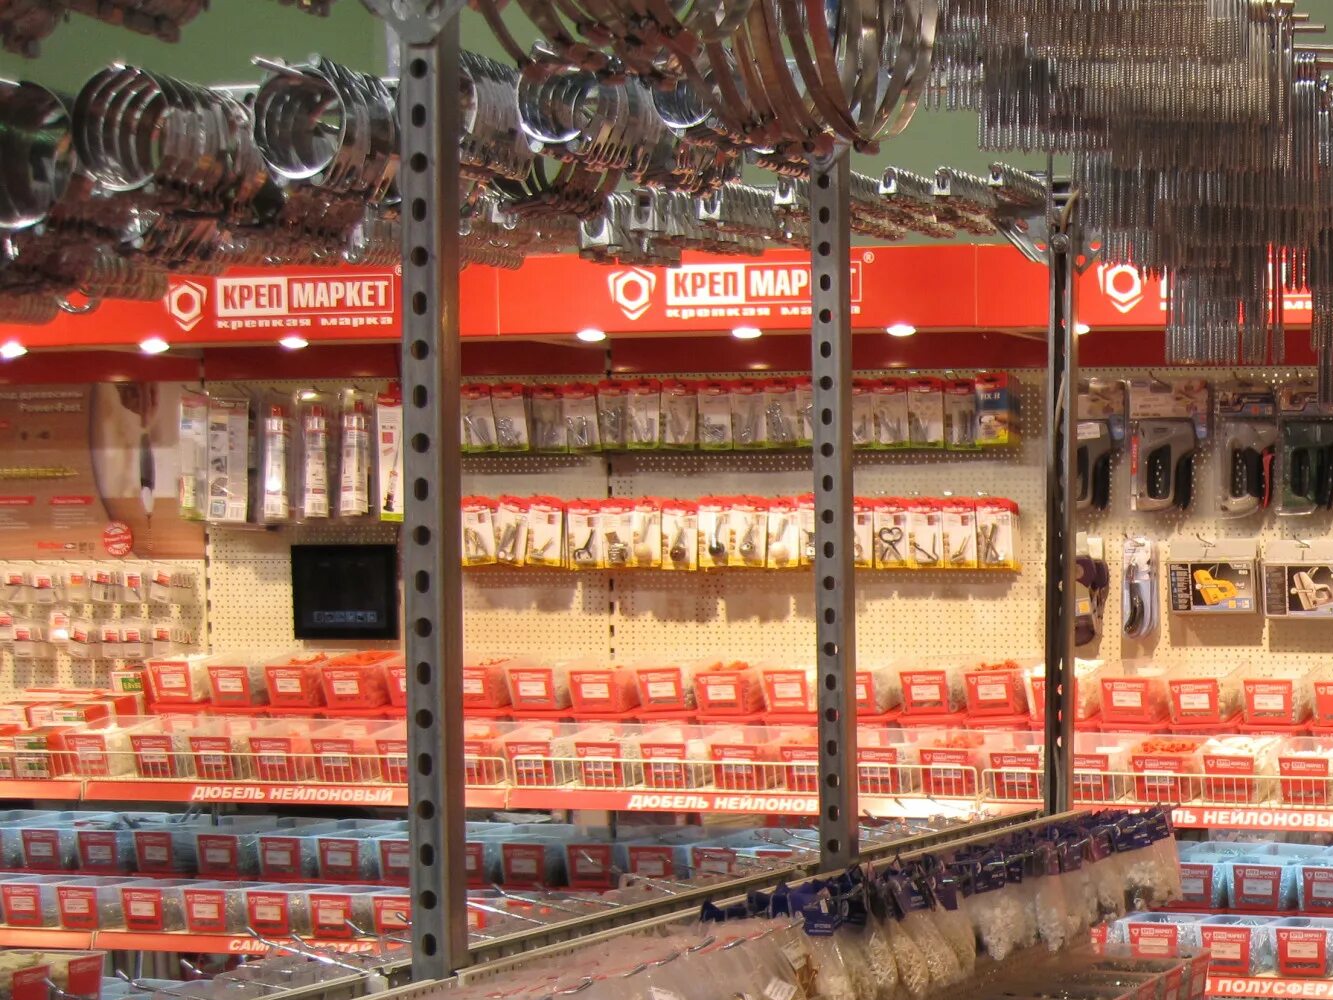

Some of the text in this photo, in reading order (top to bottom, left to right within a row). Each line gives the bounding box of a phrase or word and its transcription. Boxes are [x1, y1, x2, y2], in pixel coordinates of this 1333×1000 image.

[674, 271, 738, 298] КРЕП
[224, 281, 389, 309] КРЕП МАРКЕТ
[666, 307, 770, 319] крепкая
[216, 316, 393, 330] крепкая марка
[192, 786, 393, 802] ДЮБЕЛЬ НЕЙЛОНОВЫЙ
[628, 795, 709, 809] ДЮБЕЛЬ
